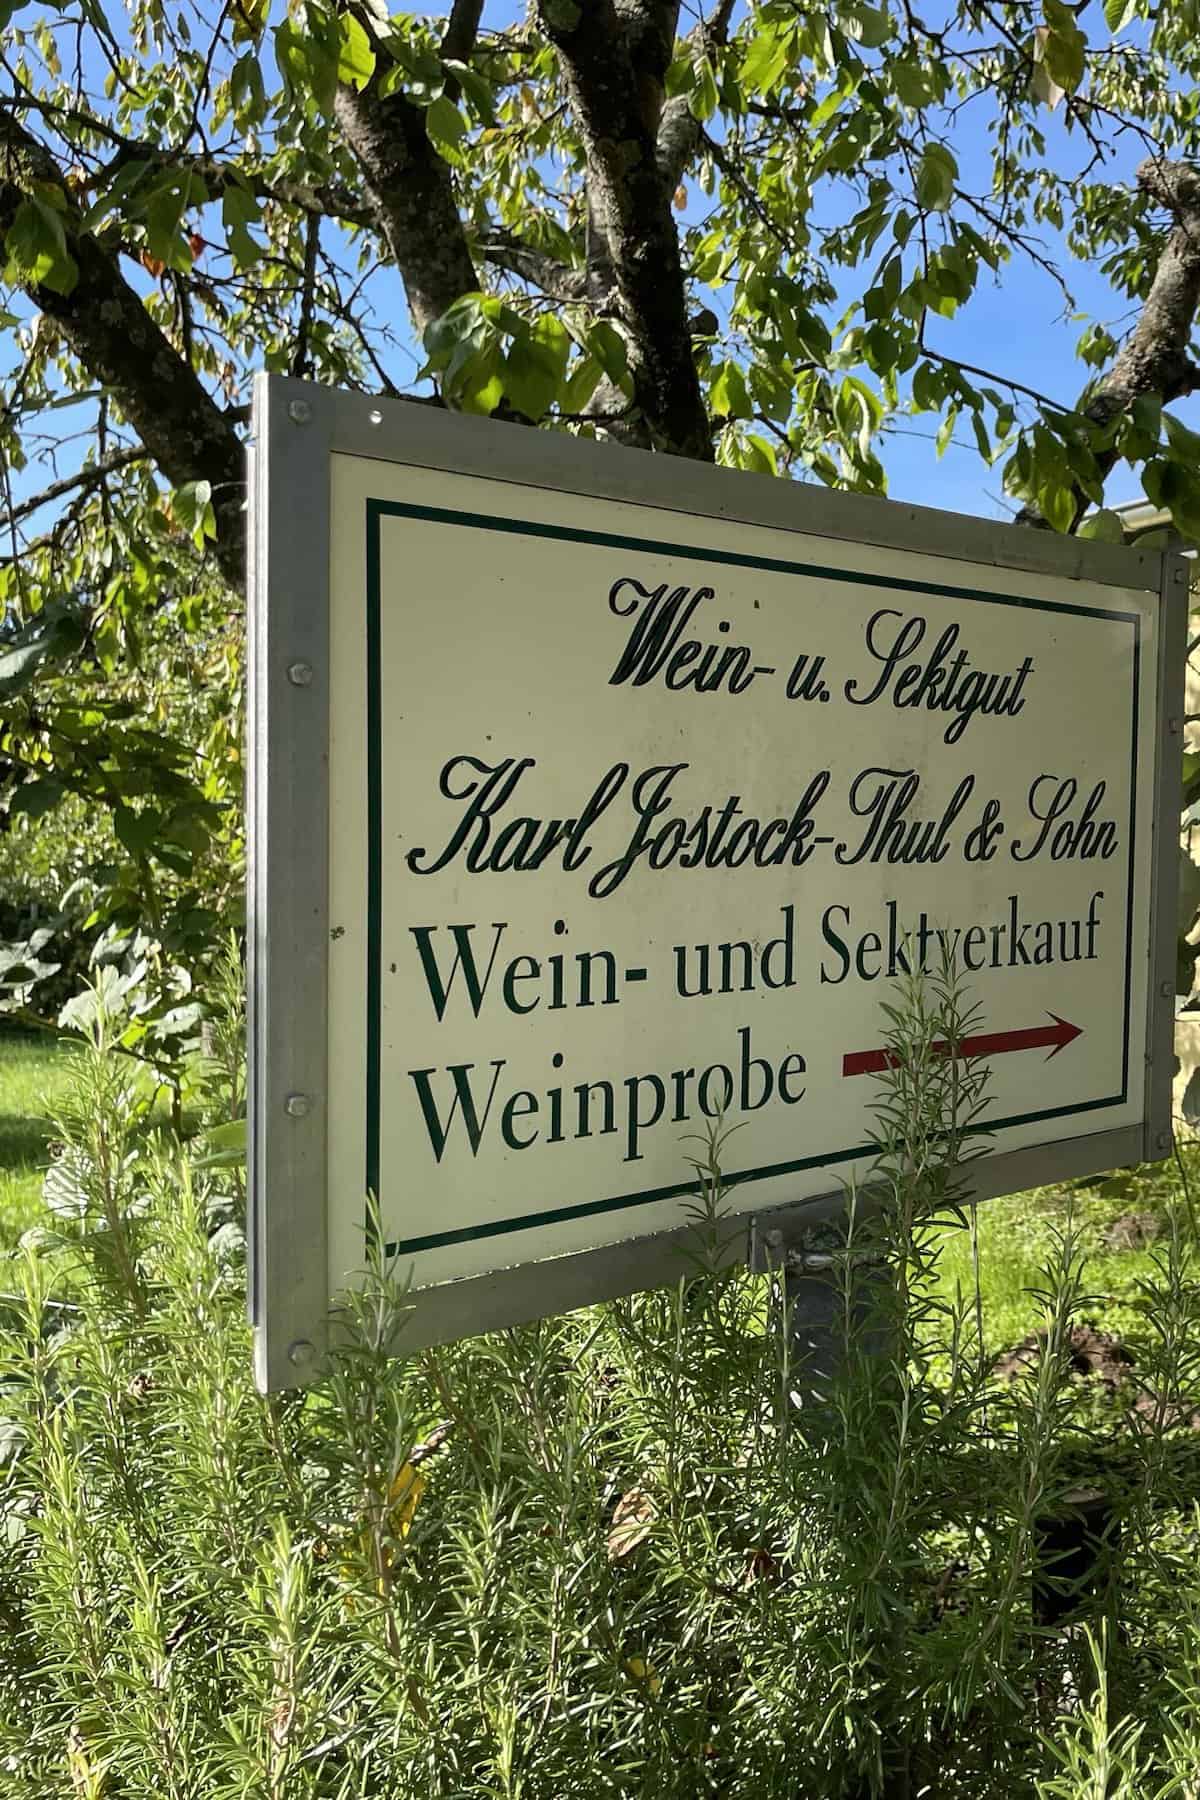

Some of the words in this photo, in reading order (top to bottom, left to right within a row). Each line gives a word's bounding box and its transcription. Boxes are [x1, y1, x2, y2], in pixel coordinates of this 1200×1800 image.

[608, 576, 777, 696] Wein-
[785, 654, 830, 702] u.
[844, 608, 1034, 745] Sektgut
[407, 755, 630, 875] Karl
[588, 762, 975, 898] Jostock-Thul
[963, 800, 1004, 862] &
[1010, 774, 1120, 862] Sohn
[408, 918, 648, 1022] Wein-
[672, 904, 797, 998] und
[819, 890, 1104, 984] Sektverkauf
[407, 1026, 807, 1164] Weinprobe
